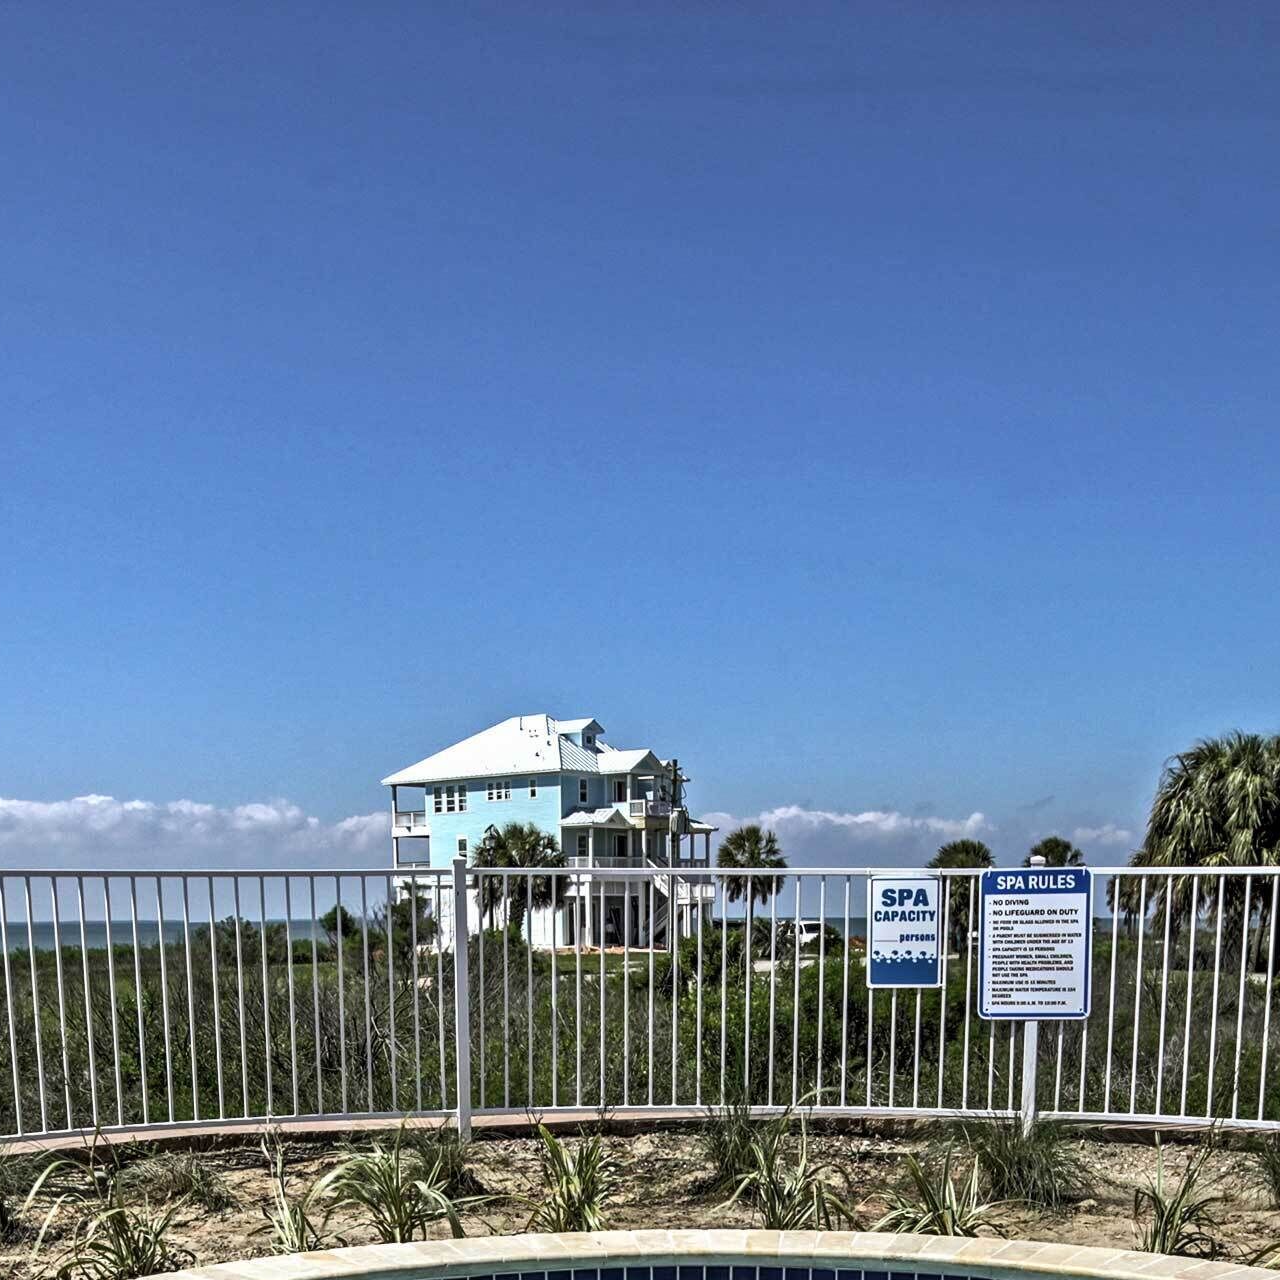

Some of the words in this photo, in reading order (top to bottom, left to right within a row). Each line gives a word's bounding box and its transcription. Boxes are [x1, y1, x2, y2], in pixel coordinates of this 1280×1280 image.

[997, 875, 1025, 889] SPA
[1029, 875, 1075, 889] RULES
[881, 888, 929, 907] SPA
[874, 911, 935, 922] CAPACITY
[900, 932, 935, 942] persons
